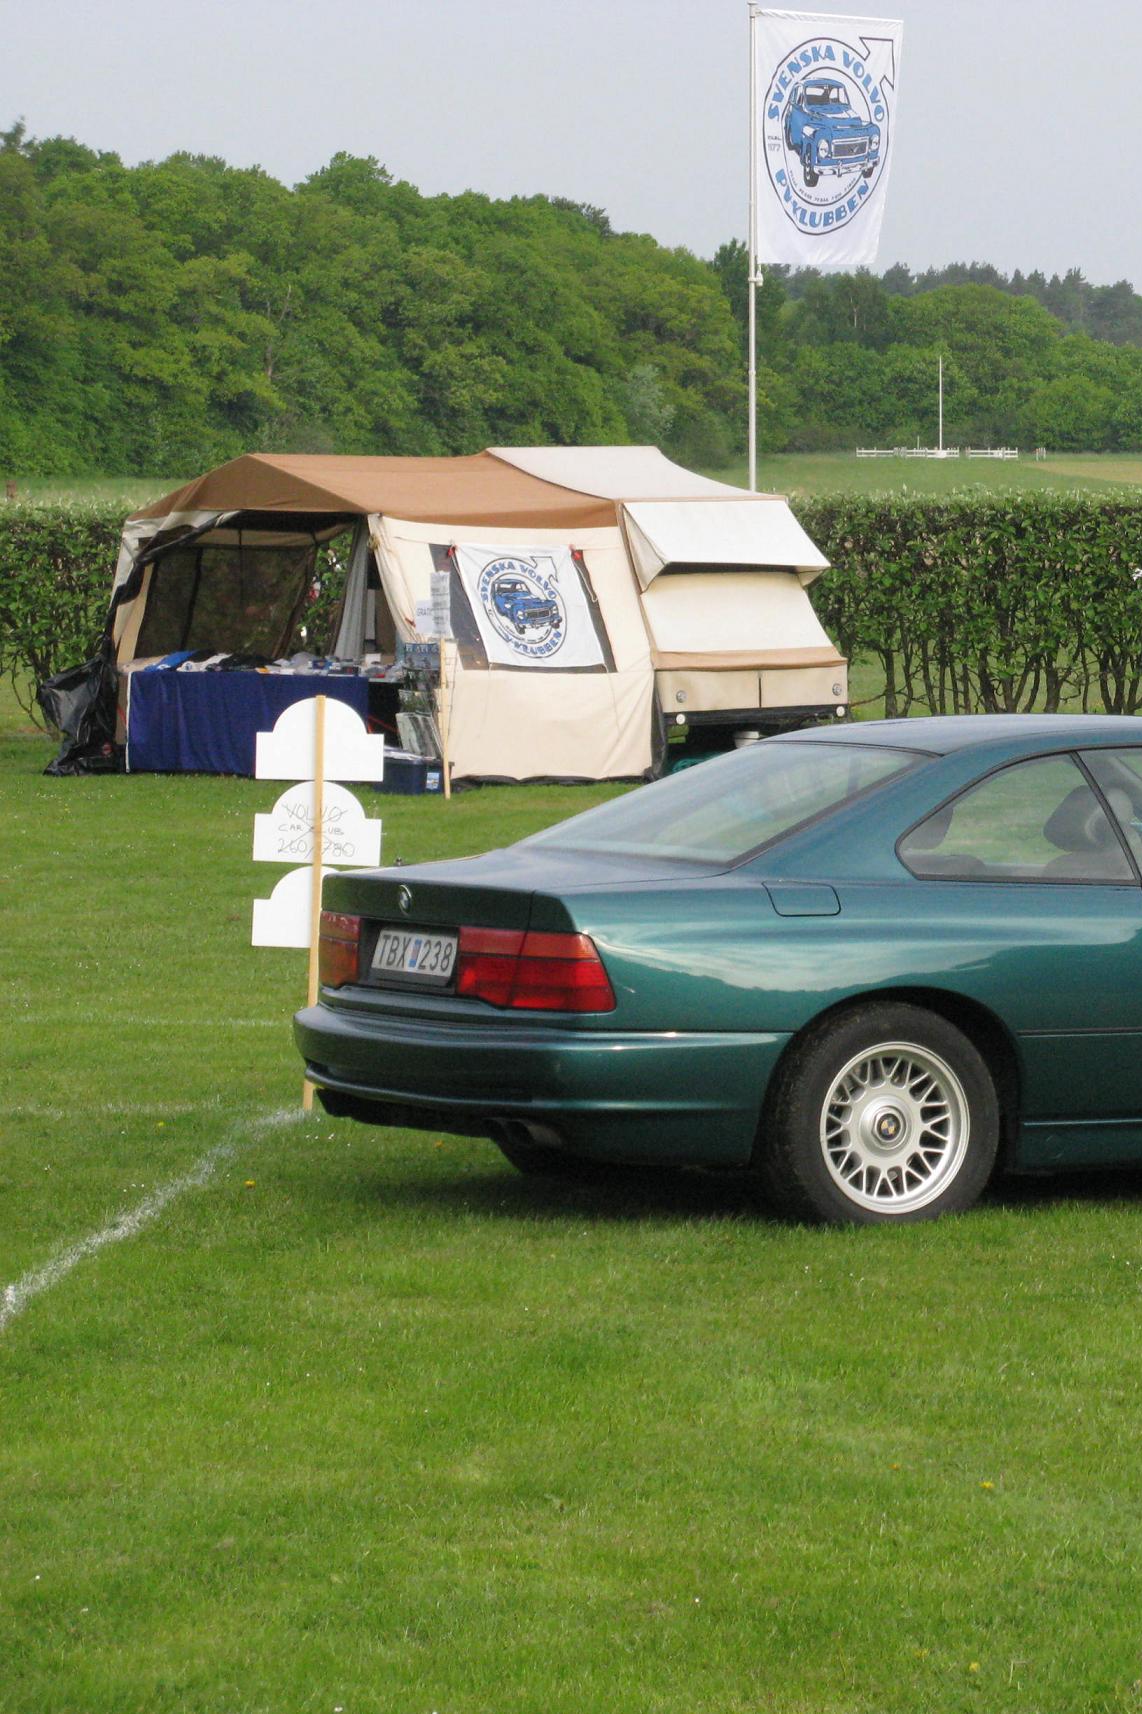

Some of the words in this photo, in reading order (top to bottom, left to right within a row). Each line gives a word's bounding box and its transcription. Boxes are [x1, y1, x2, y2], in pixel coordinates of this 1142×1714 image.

[767, 44, 836, 122] SVENSKA
[842, 50, 885, 122] VOLVO
[774, 168, 870, 228] PV-KLUBBEN
[519, 563, 557, 600] VOLVO
[378, 934, 411, 968] TBX
[418, 939, 453, 972] 238
